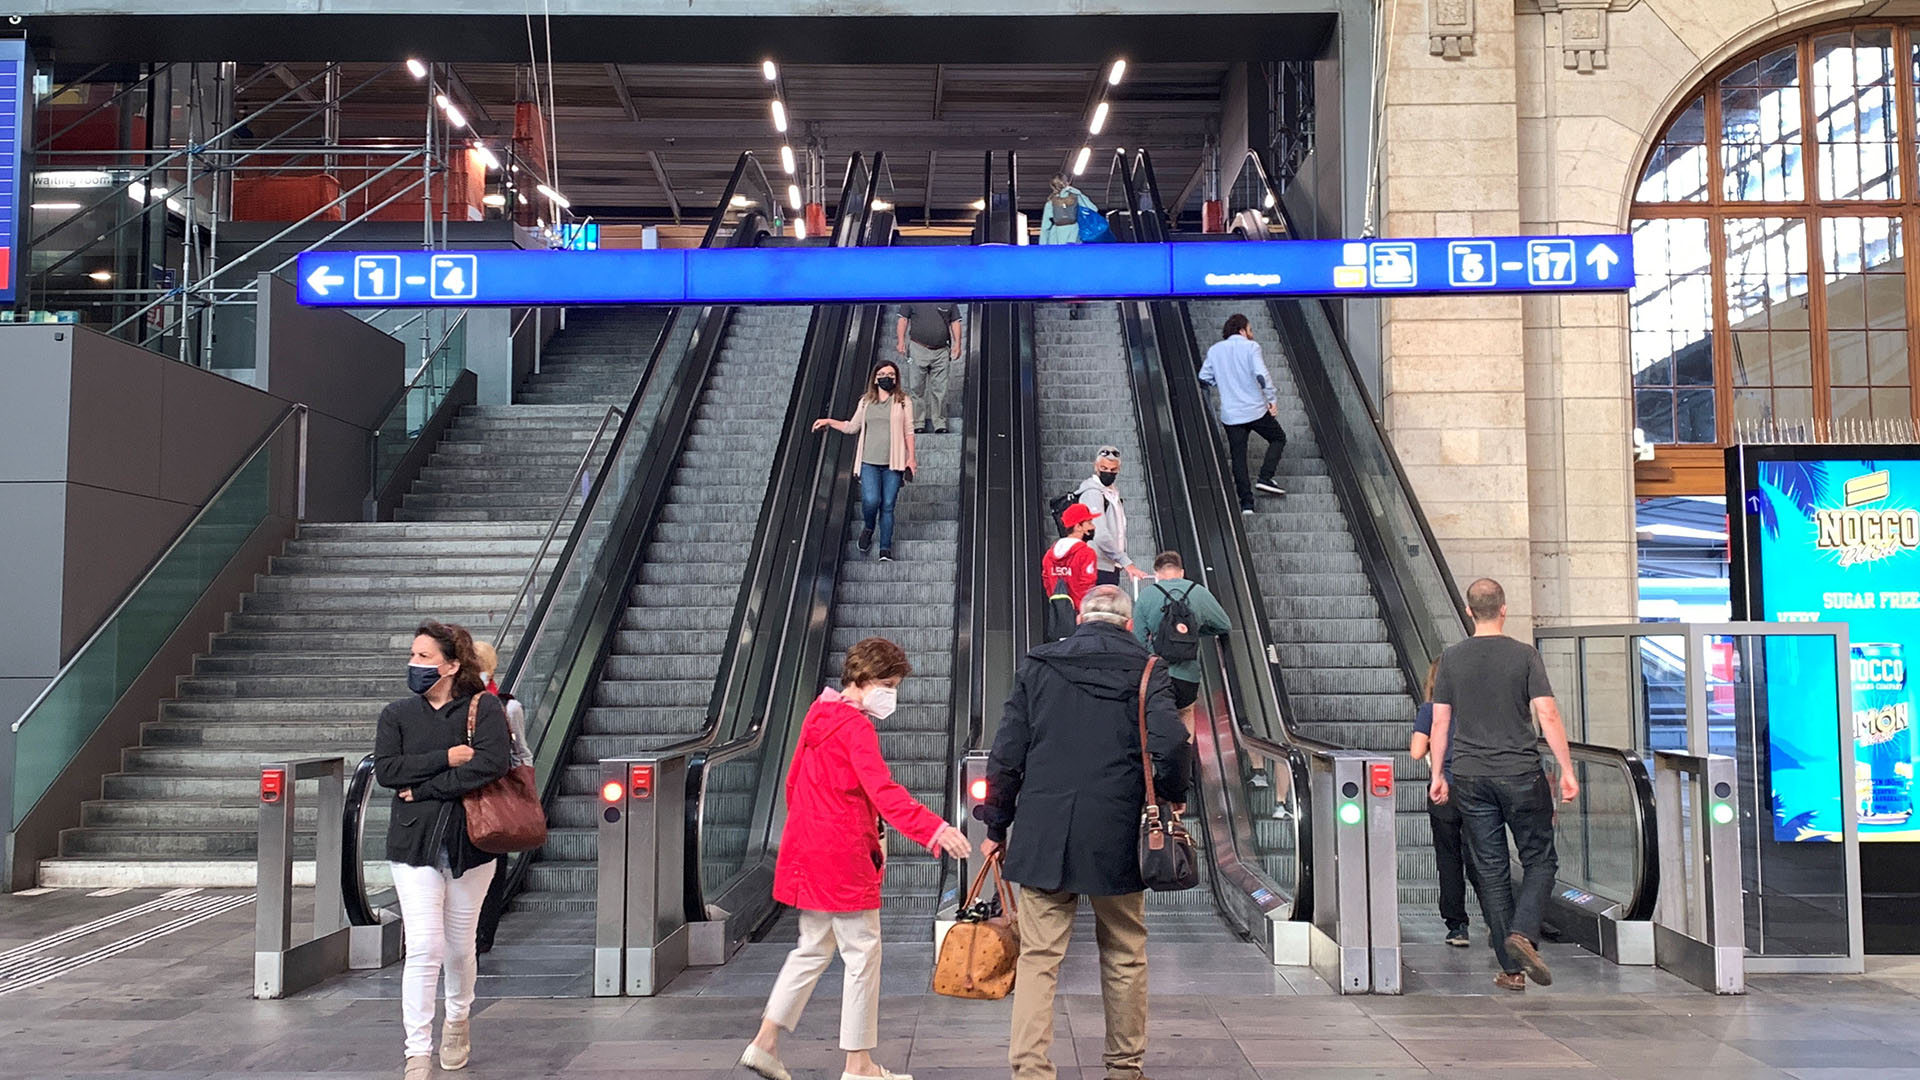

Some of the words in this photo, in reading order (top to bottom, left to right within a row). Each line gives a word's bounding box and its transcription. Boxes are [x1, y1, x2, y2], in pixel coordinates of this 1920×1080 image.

[34, 175, 76, 187] waiting
[80, 176, 112, 185] room
[368, 267, 384, 295] 1
[442, 266, 466, 295] 4
[1533, 252, 1571, 281] 17
[1817, 510, 1920, 548] NOCCO
[1822, 591, 1876, 609] SUGAR
[1879, 591, 1920, 609] FREE
